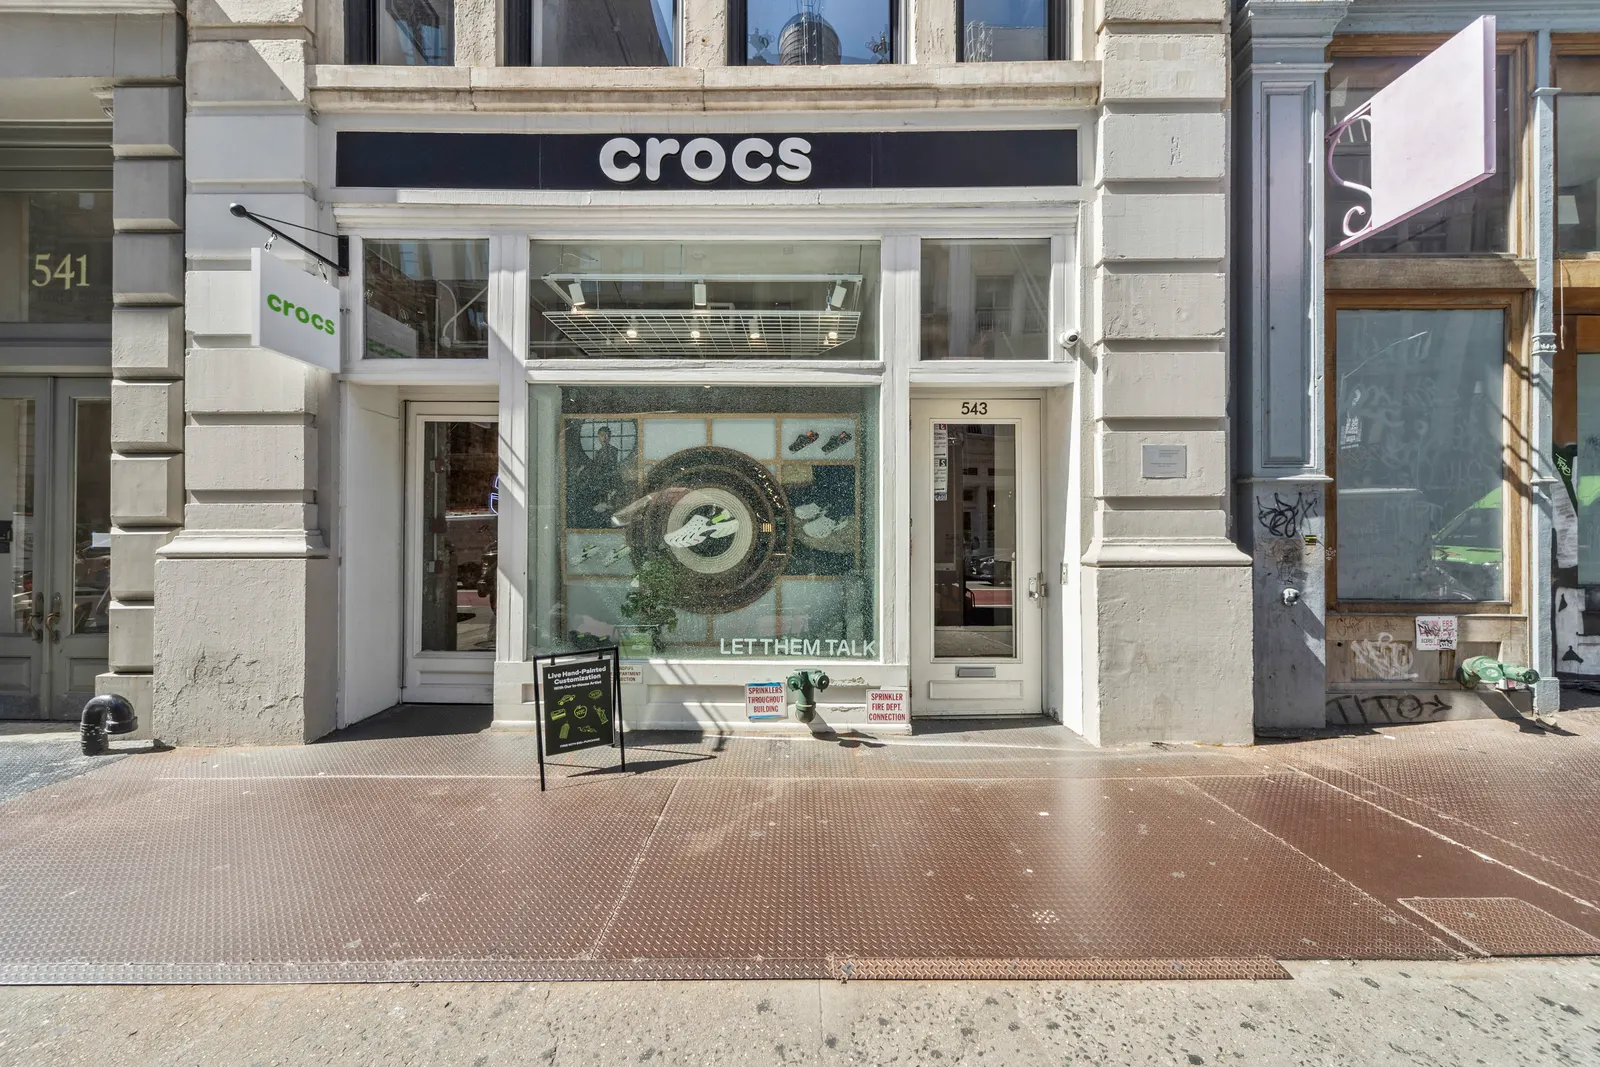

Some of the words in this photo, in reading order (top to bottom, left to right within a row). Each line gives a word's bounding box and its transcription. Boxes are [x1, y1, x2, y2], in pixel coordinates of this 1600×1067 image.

[599, 137, 812, 182] crocs
[32, 253, 90, 290] 541
[267, 294, 335, 335] crocs
[961, 402, 988, 415] 543
[720, 638, 757, 655] LET
[760, 638, 820, 656] THEM
[825, 639, 877, 657] TALK
[562, 666, 606, 677] Hand-Painted
[554, 674, 601, 684] Customization
[748, 686, 783, 695] SPRINKLERS
[748, 696, 784, 704] THROUGHOUT
[871, 693, 903, 701] SPRINKLER
[753, 705, 779, 713] BUILDING
[871, 702, 885, 711] FIRE
[886, 702, 903, 711] DEPT.
[868, 713, 906, 721] CONNECTION
